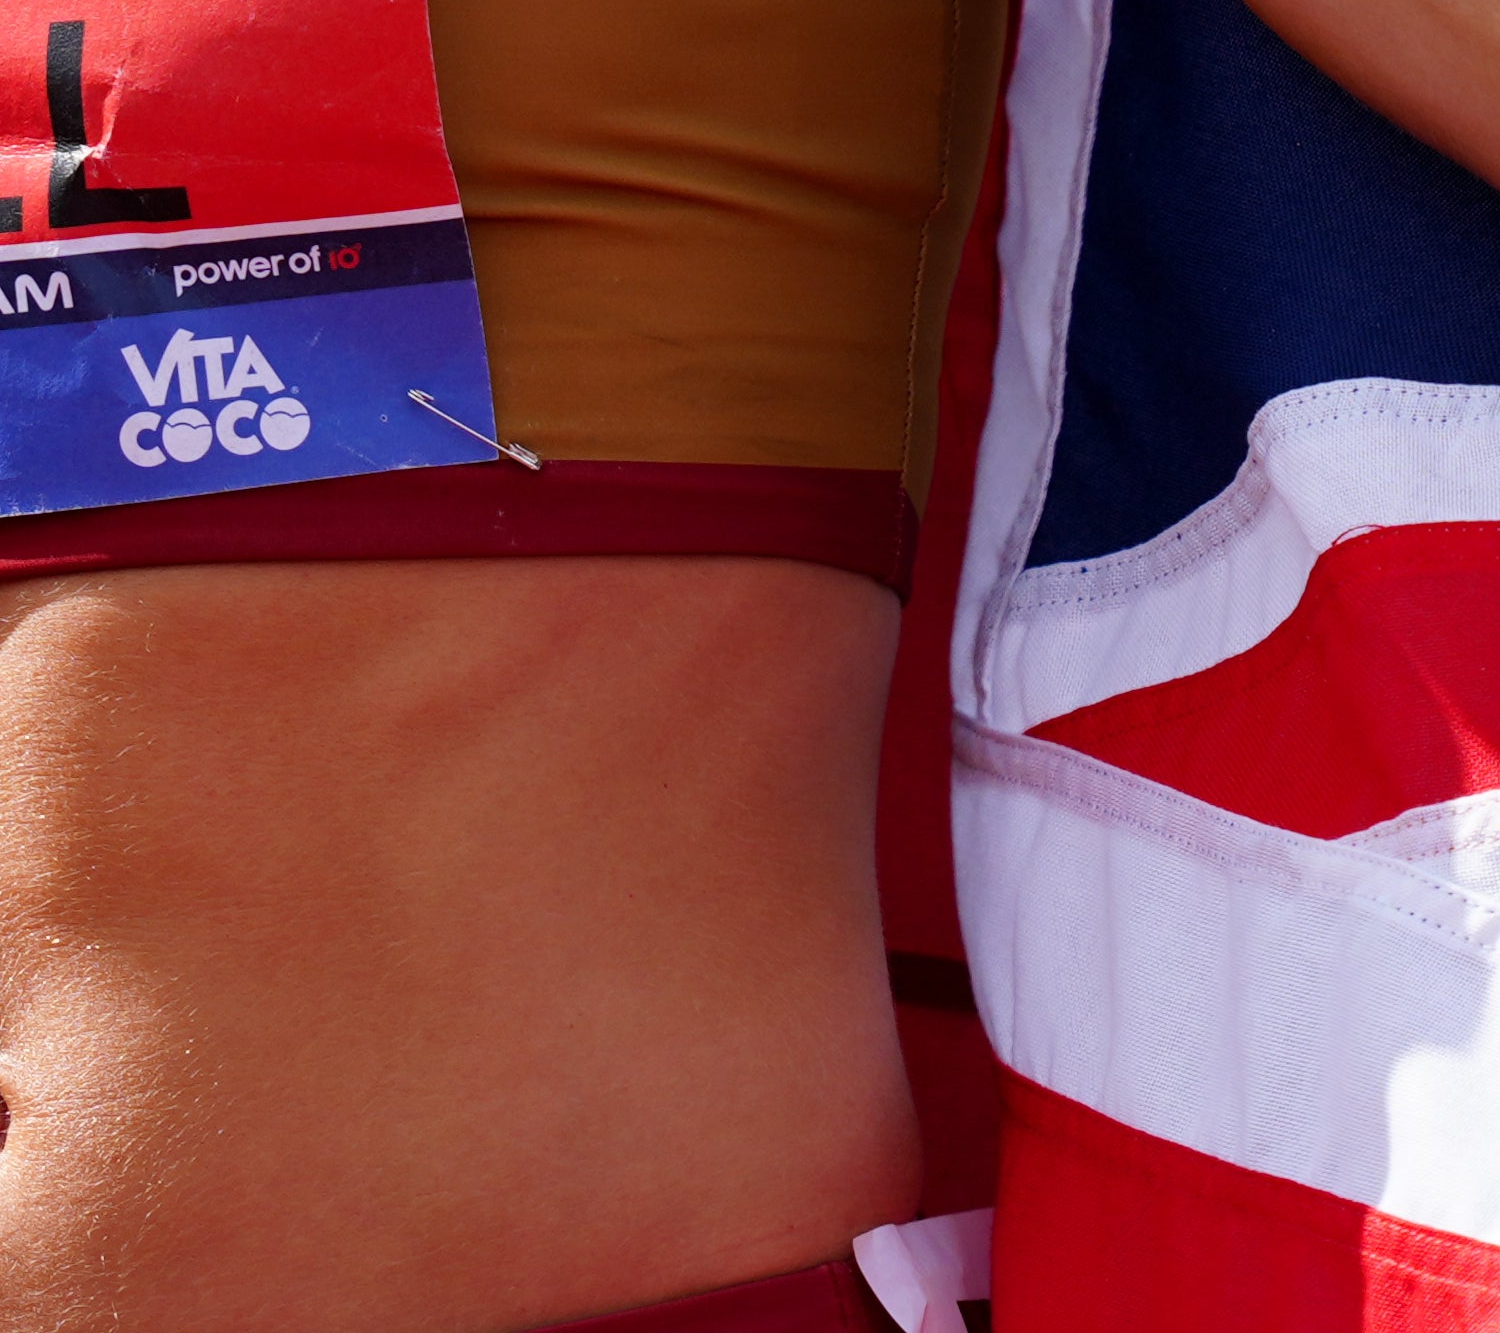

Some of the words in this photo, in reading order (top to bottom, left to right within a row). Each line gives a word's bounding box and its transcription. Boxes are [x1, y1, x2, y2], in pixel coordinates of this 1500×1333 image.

[172, 253, 285, 298] power
[287, 244, 322, 275] of
[120, 327, 286, 408] VITA
[118, 396, 311, 468] COCO
